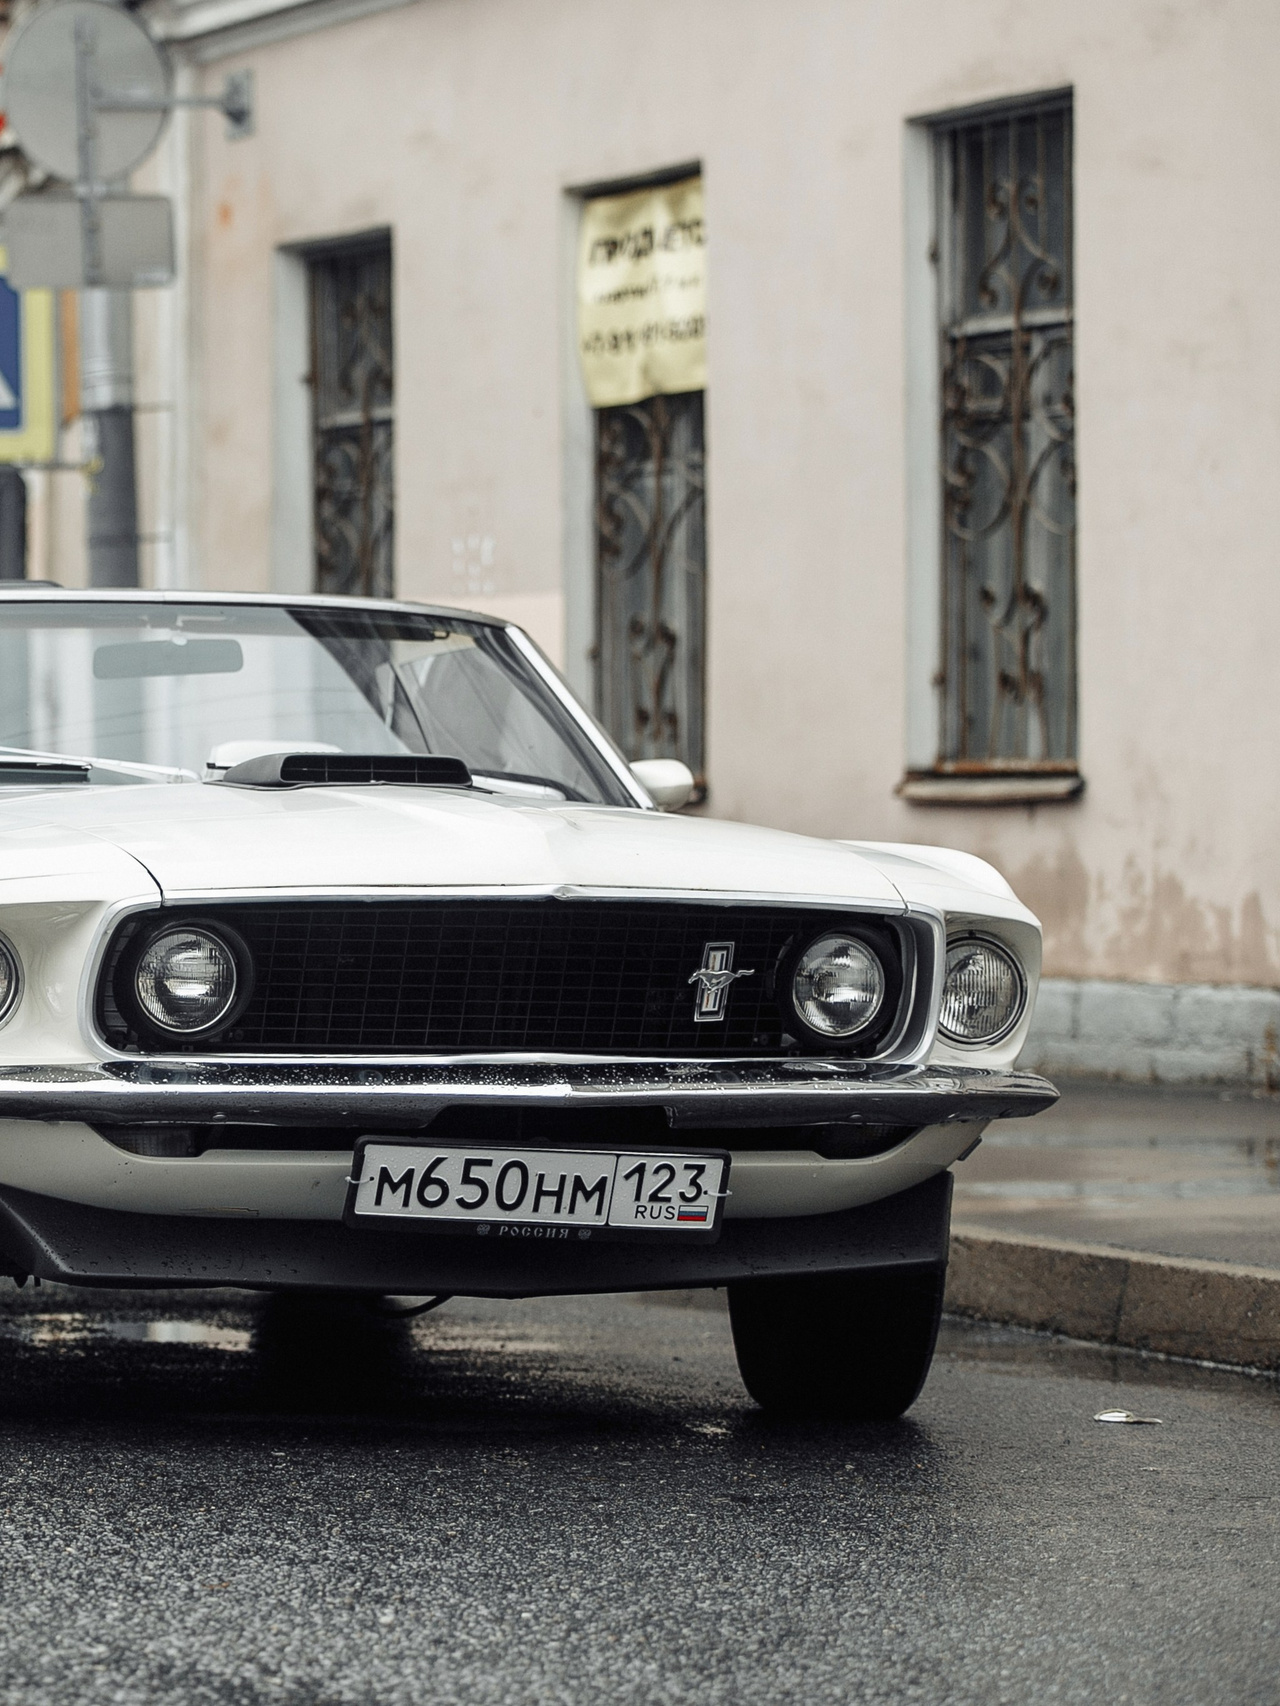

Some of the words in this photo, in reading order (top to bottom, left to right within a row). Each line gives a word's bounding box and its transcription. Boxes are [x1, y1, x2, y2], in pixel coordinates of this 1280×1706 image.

[374, 1156, 608, 1216] М650НМ
[623, 1161, 707, 1203] 123
[634, 1204, 676, 1220] RUS
[499, 1225, 569, 1239] РОССИЯ
